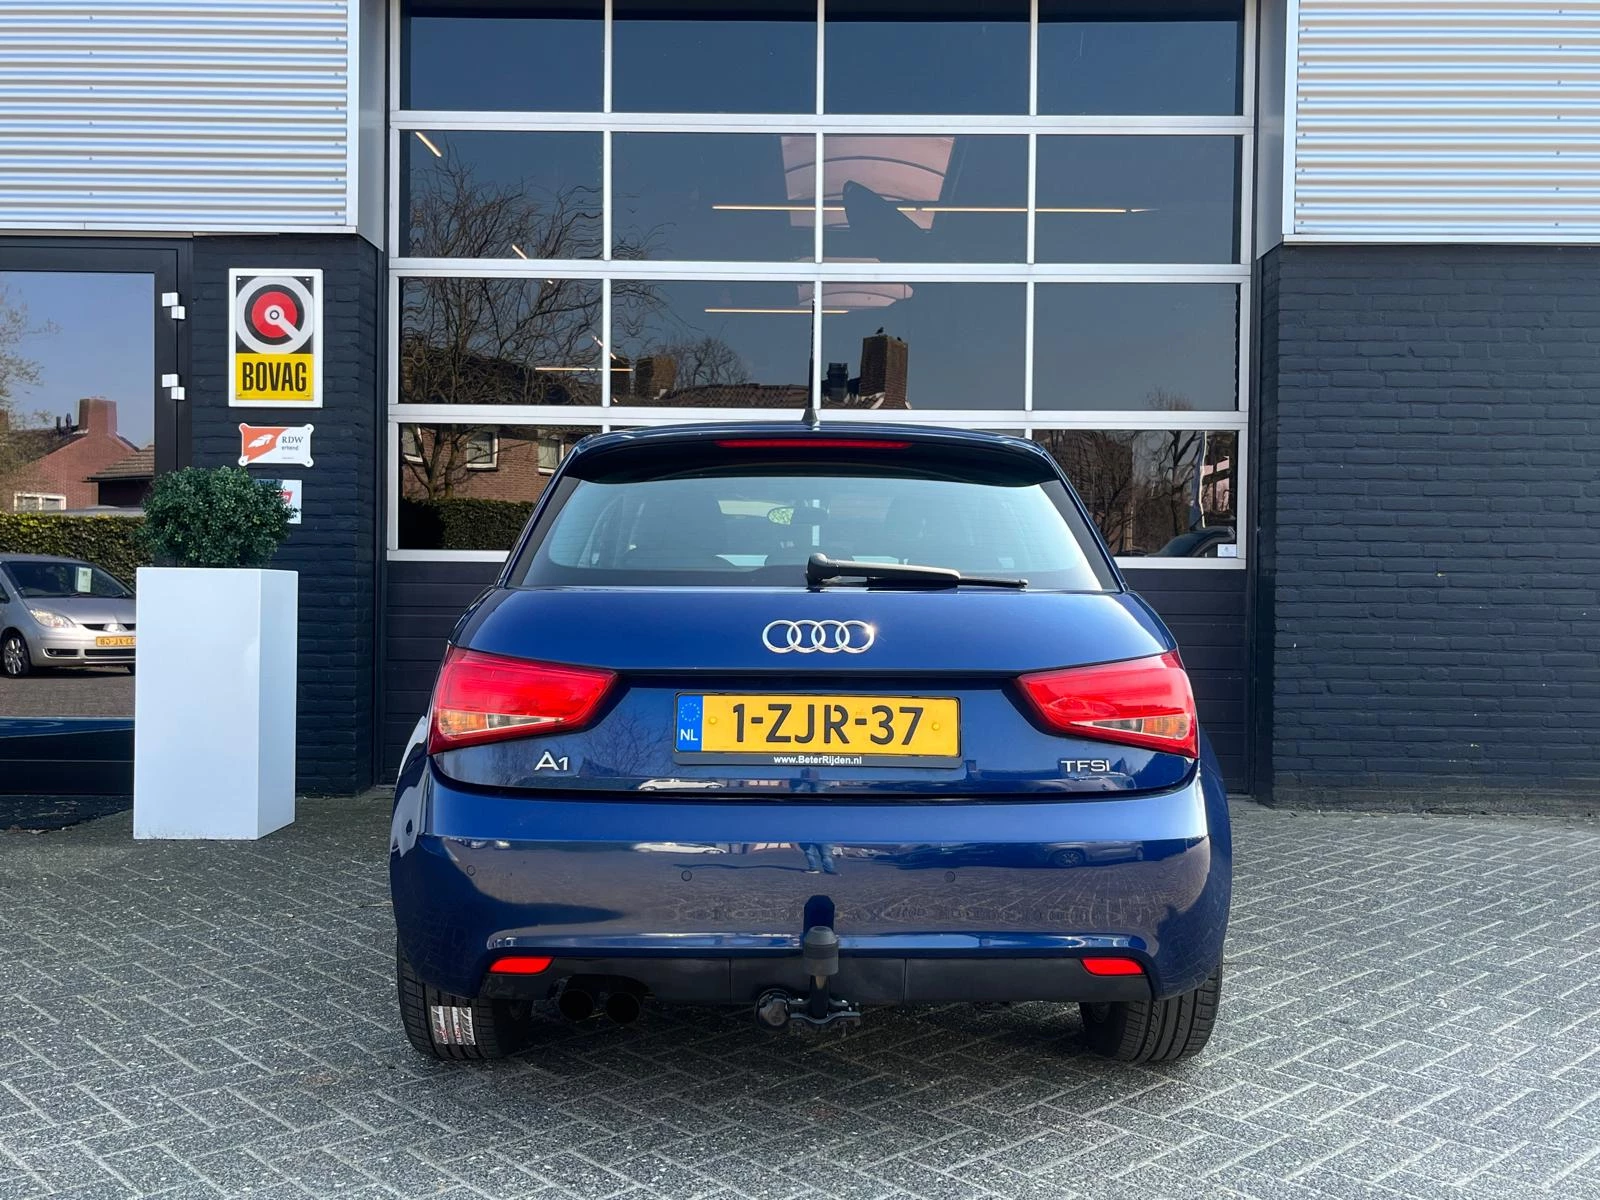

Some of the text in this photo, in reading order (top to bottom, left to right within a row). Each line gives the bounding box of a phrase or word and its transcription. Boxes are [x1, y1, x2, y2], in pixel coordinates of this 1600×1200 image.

[243, 362, 307, 392] BOVAG
[282, 436, 303, 444] RDW
[733, 703, 924, 745] 1-ZJR-37
[680, 729, 698, 742] NL
[534, 751, 569, 771] A1
[773, 755, 862, 766] www.BeterRijden.nl
[1060, 759, 1110, 772] TFSI
